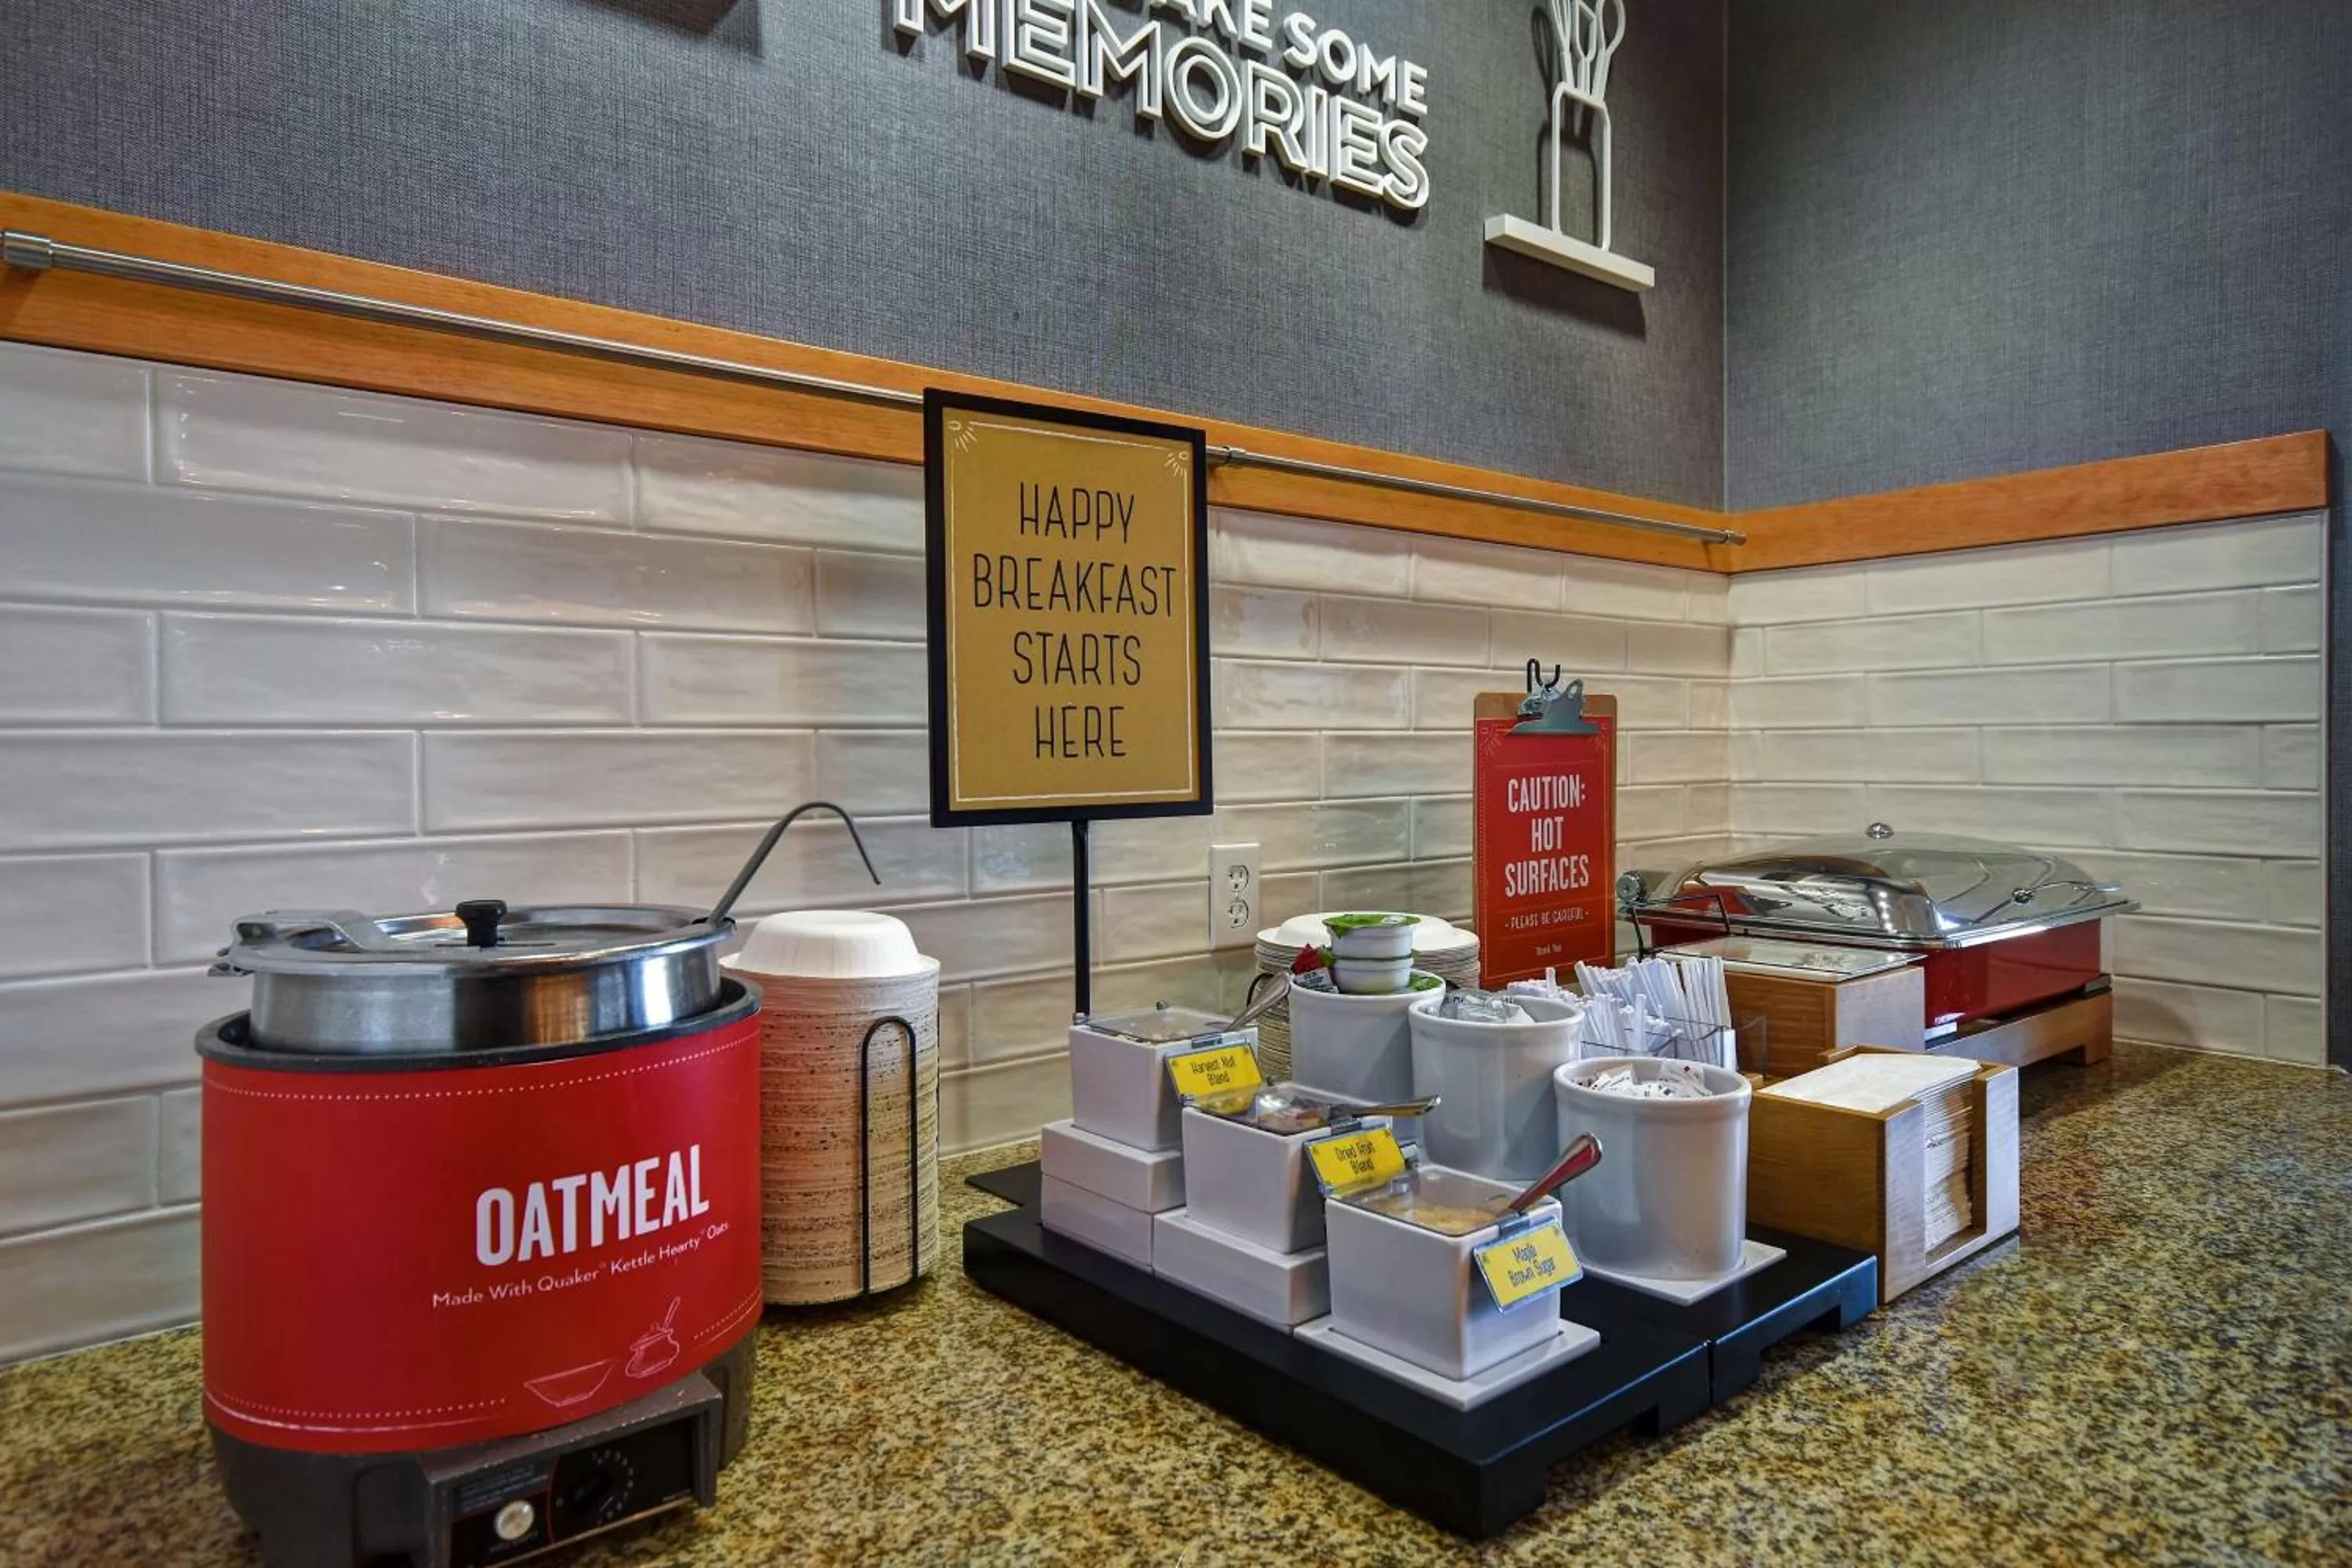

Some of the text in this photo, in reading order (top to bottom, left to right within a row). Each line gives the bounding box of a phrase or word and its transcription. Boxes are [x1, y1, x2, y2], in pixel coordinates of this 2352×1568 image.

[1283, 11, 1428, 116] SOME
[1019, 481, 1135, 544] HAPPY
[972, 553, 1177, 617] BREAKFAST
[1012, 630, 1142, 686] STARTS
[1035, 706, 1127, 758] HERE
[1507, 774, 1586, 814] CAUTION:
[1531, 816, 1564, 853] HOT
[1504, 854, 1590, 898] SURFACES
[1189, 1058, 1221, 1075] Harvest
[1207, 1069, 1230, 1087] Blend
[475, 1144, 710, 1267] OATMEAL
[432, 1291, 484, 1308] Made
[488, 1280, 533, 1301] With
[610, 1252, 655, 1276] Kettle
[659, 1236, 701, 1261] Hearty
[706, 1221, 729, 1241] Oats
